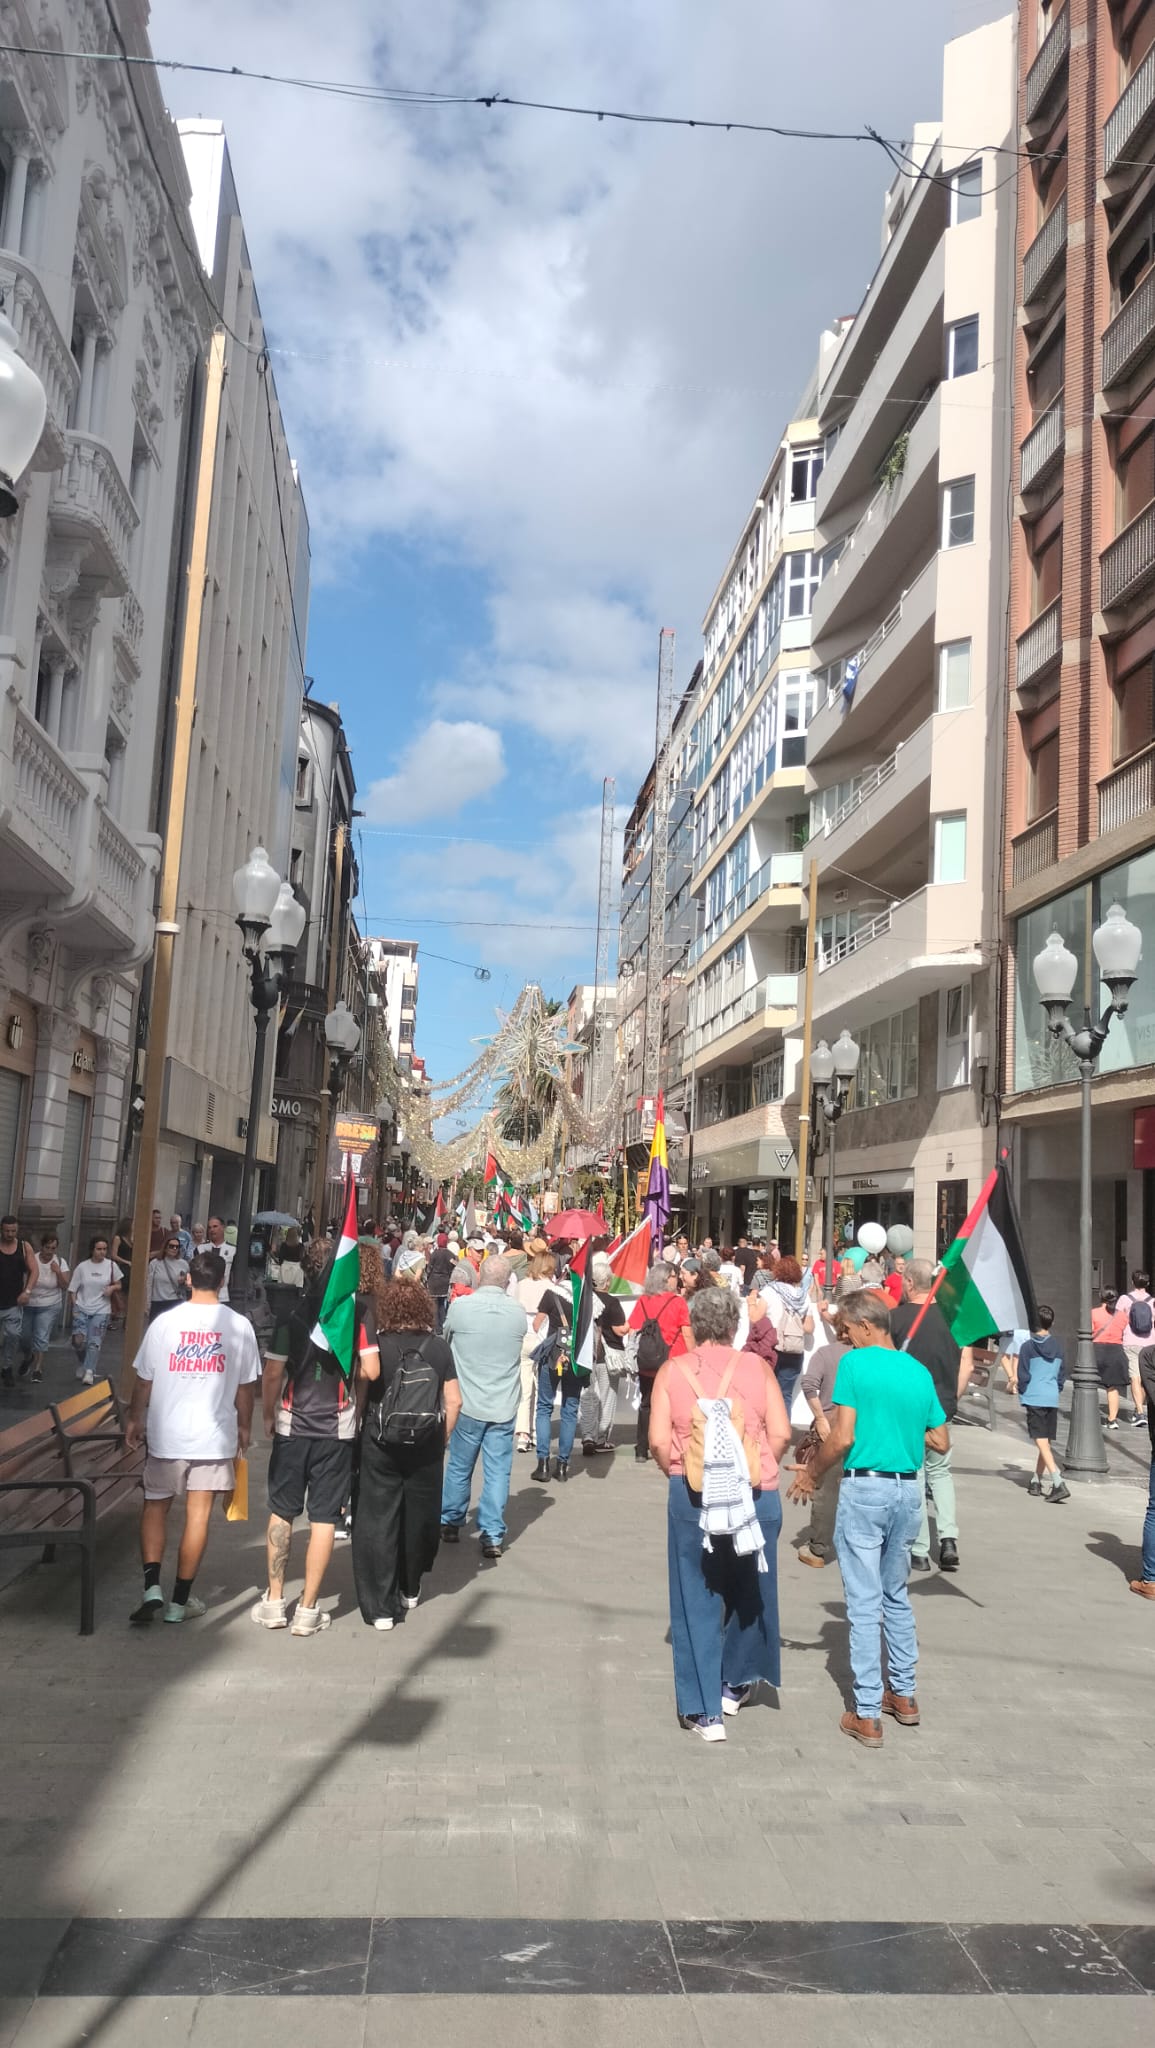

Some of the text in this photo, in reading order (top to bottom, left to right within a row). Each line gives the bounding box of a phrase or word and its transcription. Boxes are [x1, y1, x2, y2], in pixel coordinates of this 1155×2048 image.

[180, 1331, 223, 1348] TRUST
[176, 1342, 223, 1362] YOUR
[169, 1353, 226, 1373] DREAMS
